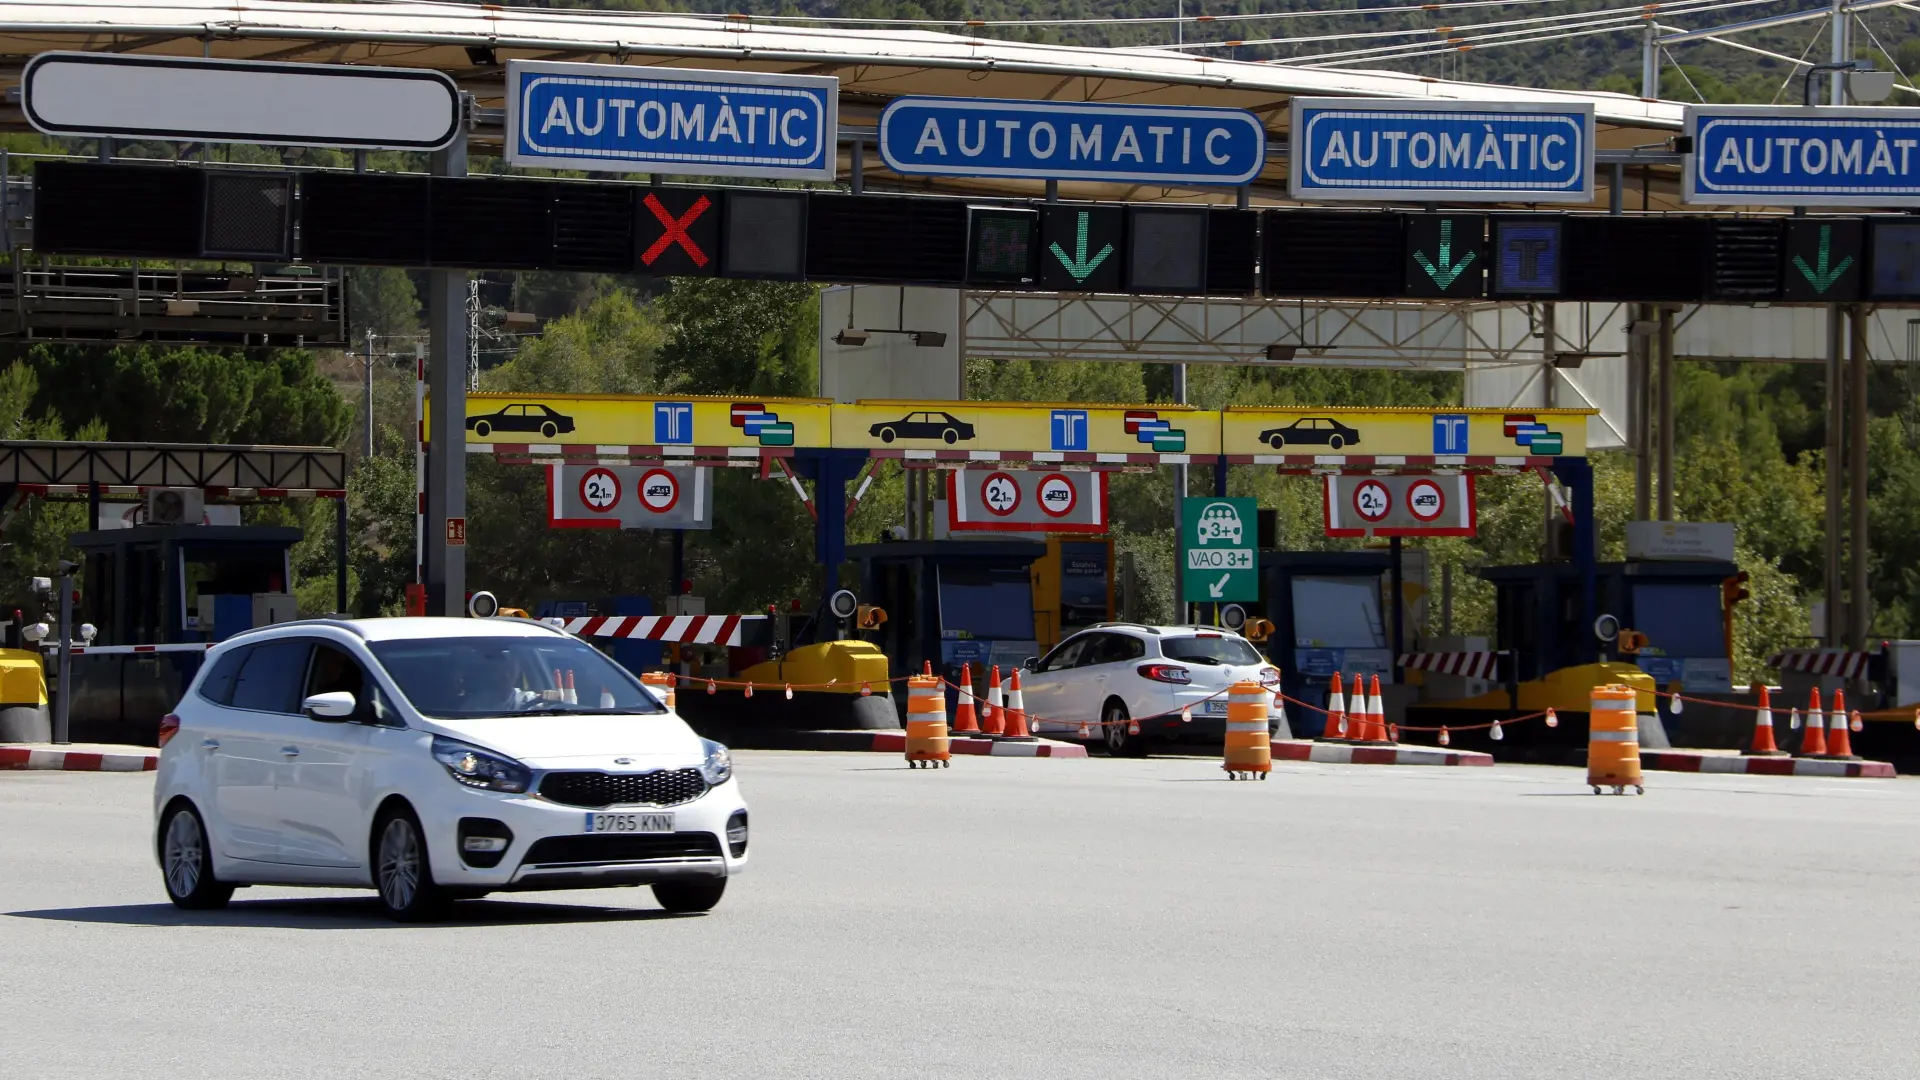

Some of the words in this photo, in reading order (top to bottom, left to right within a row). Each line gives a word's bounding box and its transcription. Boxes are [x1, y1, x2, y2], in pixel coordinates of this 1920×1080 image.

[540, 95, 809, 149] AUTOMÀTIC
[914, 117, 1233, 166] AUTOMATIC
[1320, 123, 1567, 171] AUTOMÀTIC
[1210, 522, 1232, 537] 3+
[1190, 552, 1223, 566] VAO
[1227, 552, 1250, 566] 3+
[596, 815, 637, 831] 3765
[641, 814, 672, 831] KNN
